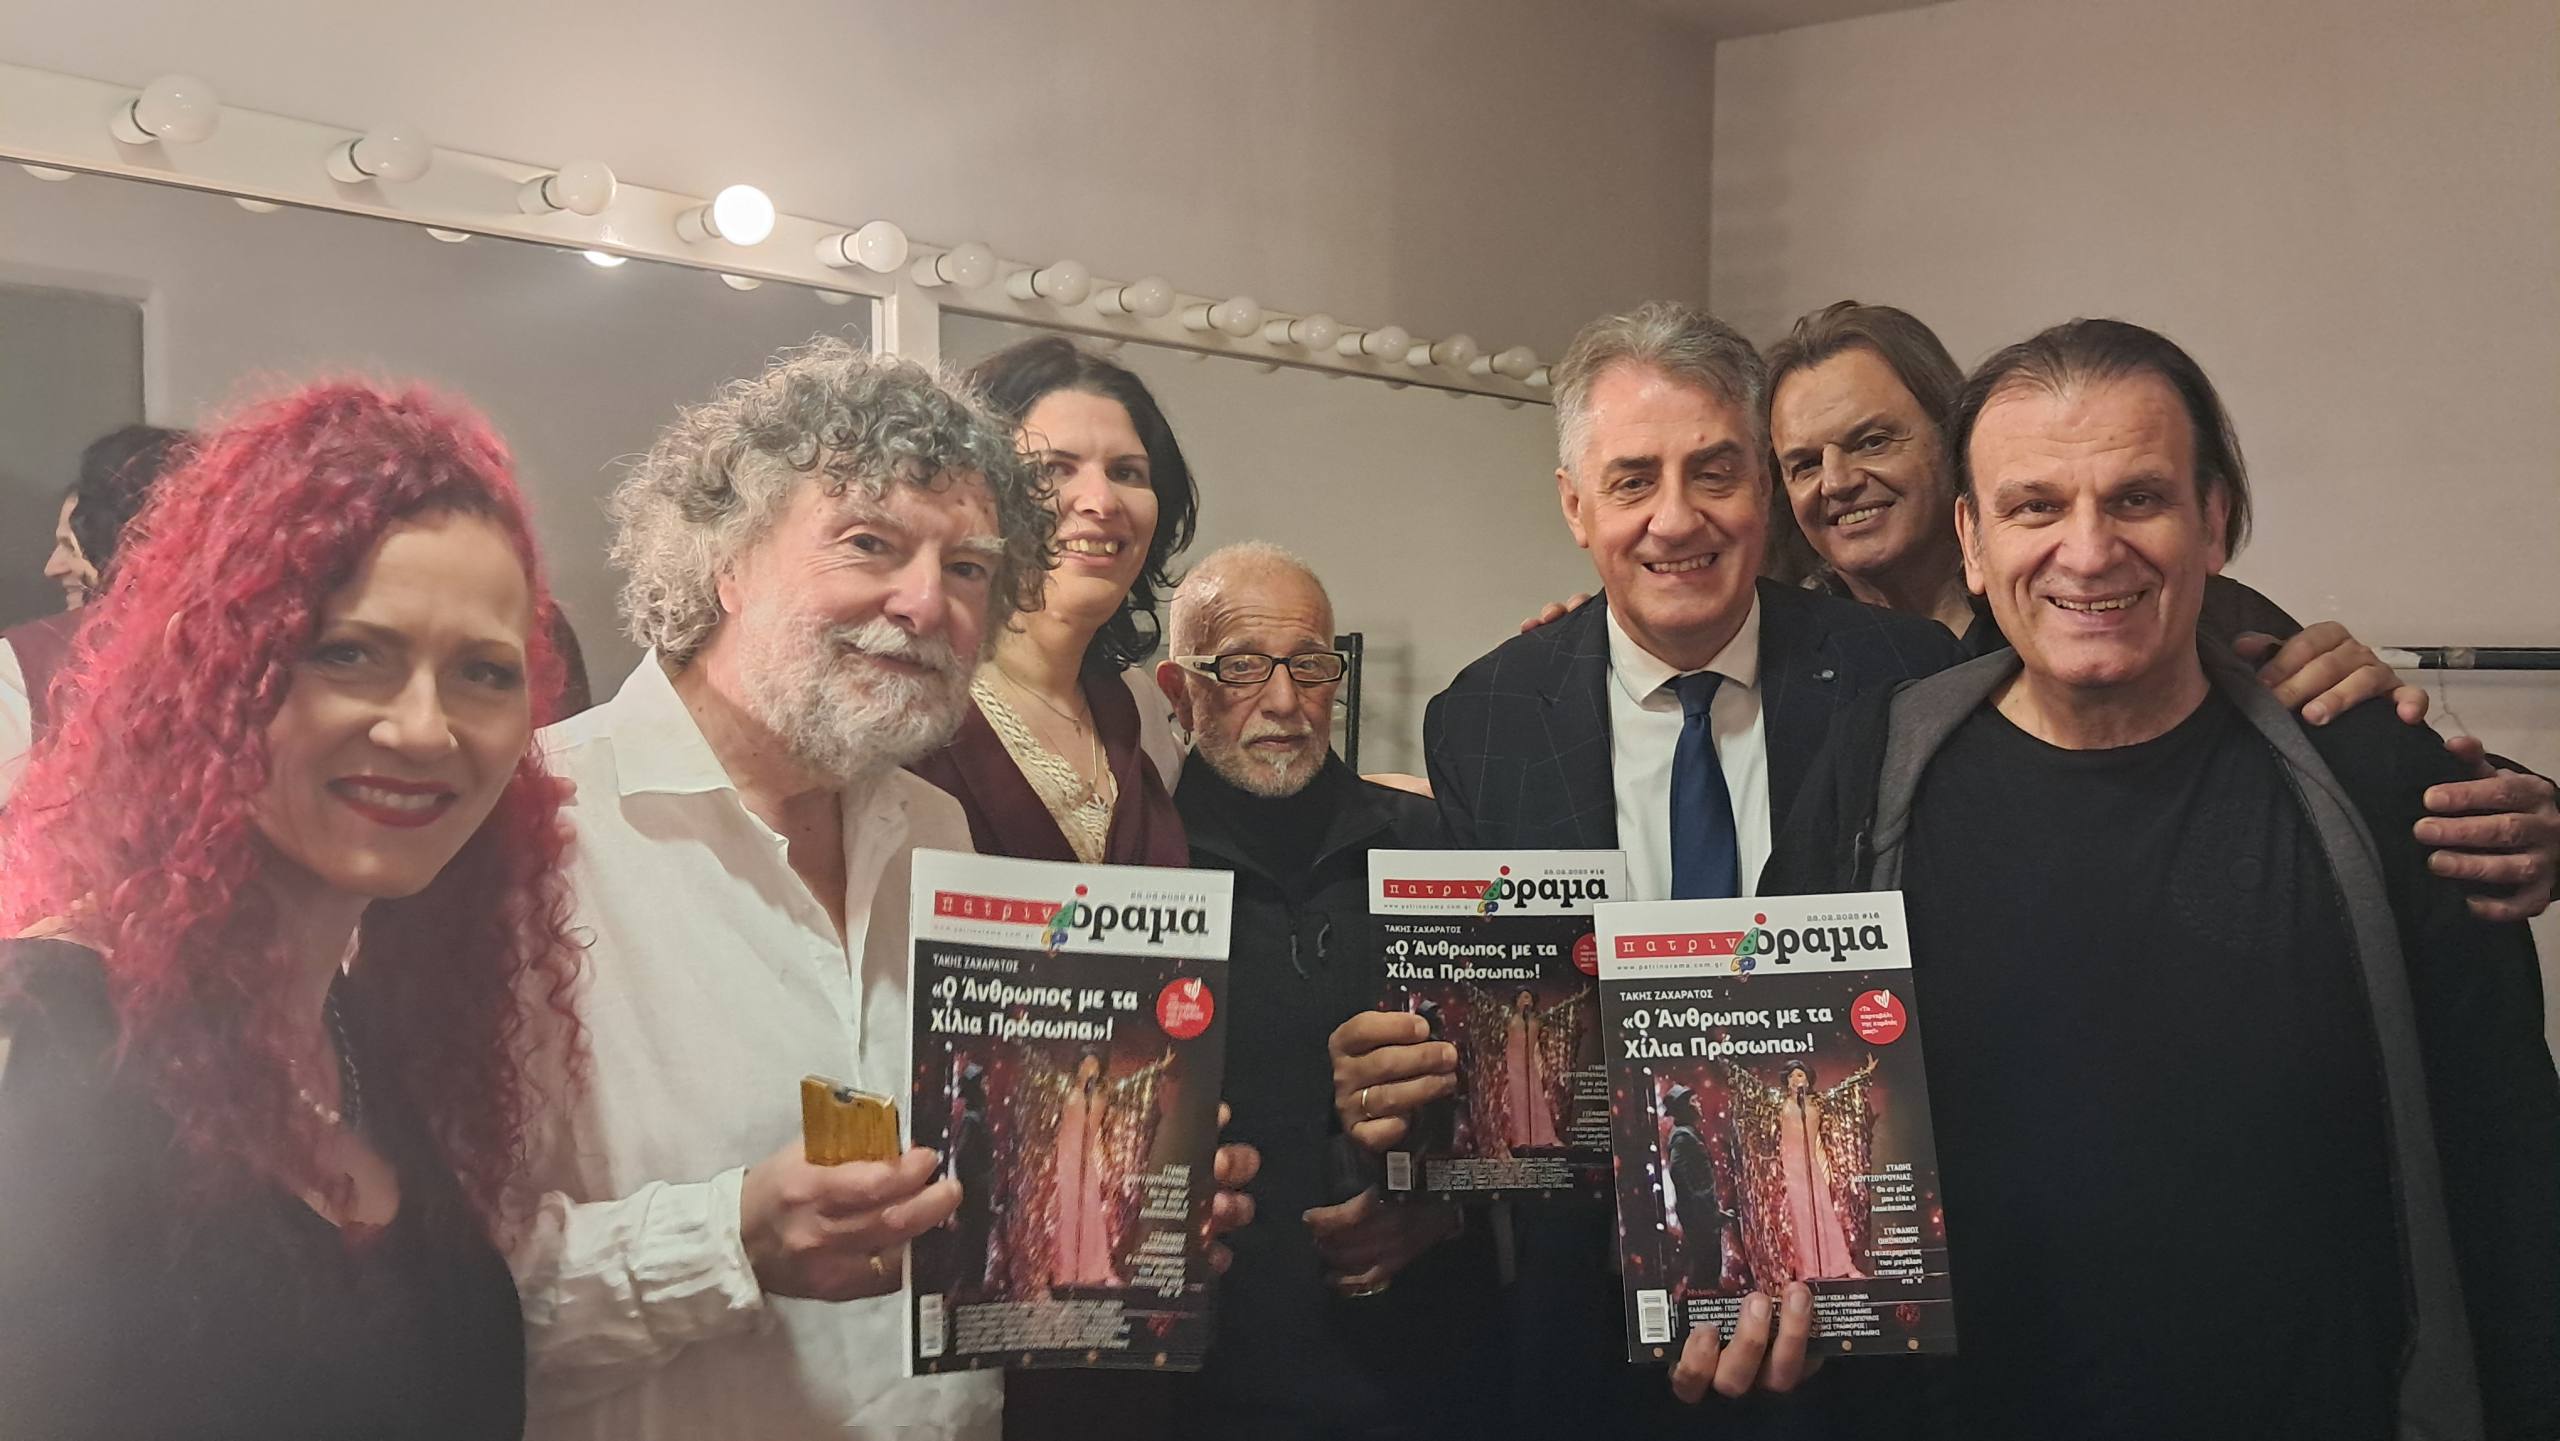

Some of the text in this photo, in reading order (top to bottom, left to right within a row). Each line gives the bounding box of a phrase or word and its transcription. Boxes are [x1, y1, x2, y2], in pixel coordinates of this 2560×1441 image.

[1384, 924, 1462, 934] ΤΑΚΗΣ ΖΑΧΑΡΑΤΟΣ
[1511, 943, 1531, 960] με
[1536, 943, 1558, 956] τα
[1385, 961, 1541, 983] Χίλια Πρόσωπα»!
[1078, 988, 1106, 1013] με
[1111, 989, 1138, 1010] τα
[1619, 989, 1713, 1001] ΤΑΚΗΣ ΖΑΧΑΡΑΤΟΣ
[930, 1006, 1114, 1041] Χίλια Πρόσωπα»!
[1776, 1008, 1801, 1028] με
[1806, 1007, 1833, 1023] τα
[1624, 1033, 1815, 1061] Χίλια Πρόσωπα»!
